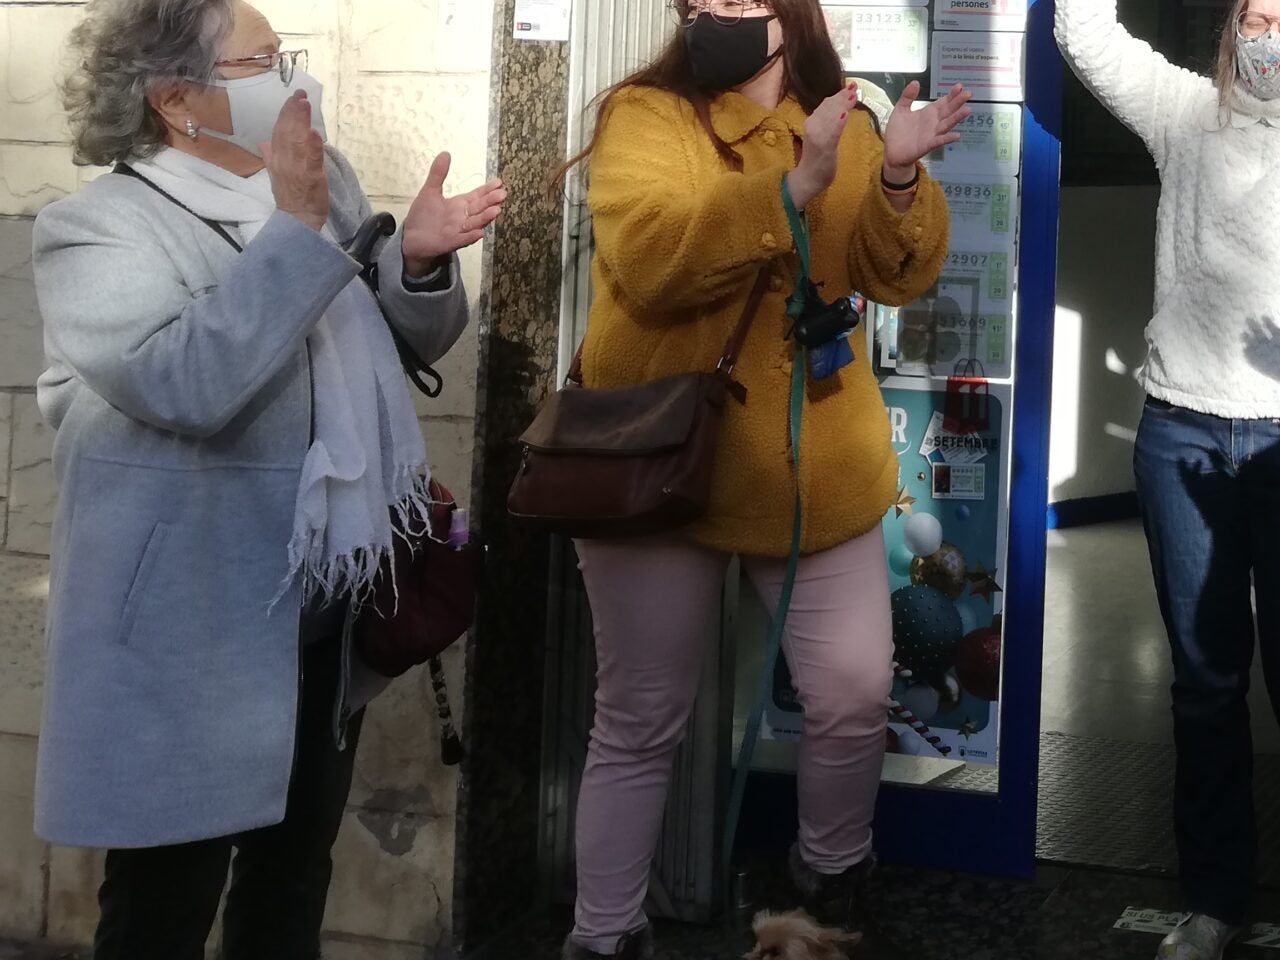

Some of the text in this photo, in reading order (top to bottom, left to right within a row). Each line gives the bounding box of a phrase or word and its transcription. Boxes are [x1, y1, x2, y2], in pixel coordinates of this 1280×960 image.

[950, 0, 989, 8] persones
[856, 13, 902, 23] 33123
[944, 185, 992, 197] 49836
[933, 436, 998, 449] SETEMBRE
[1139, 912, 1155, 920] US
[1157, 915, 1179, 923] PLA
